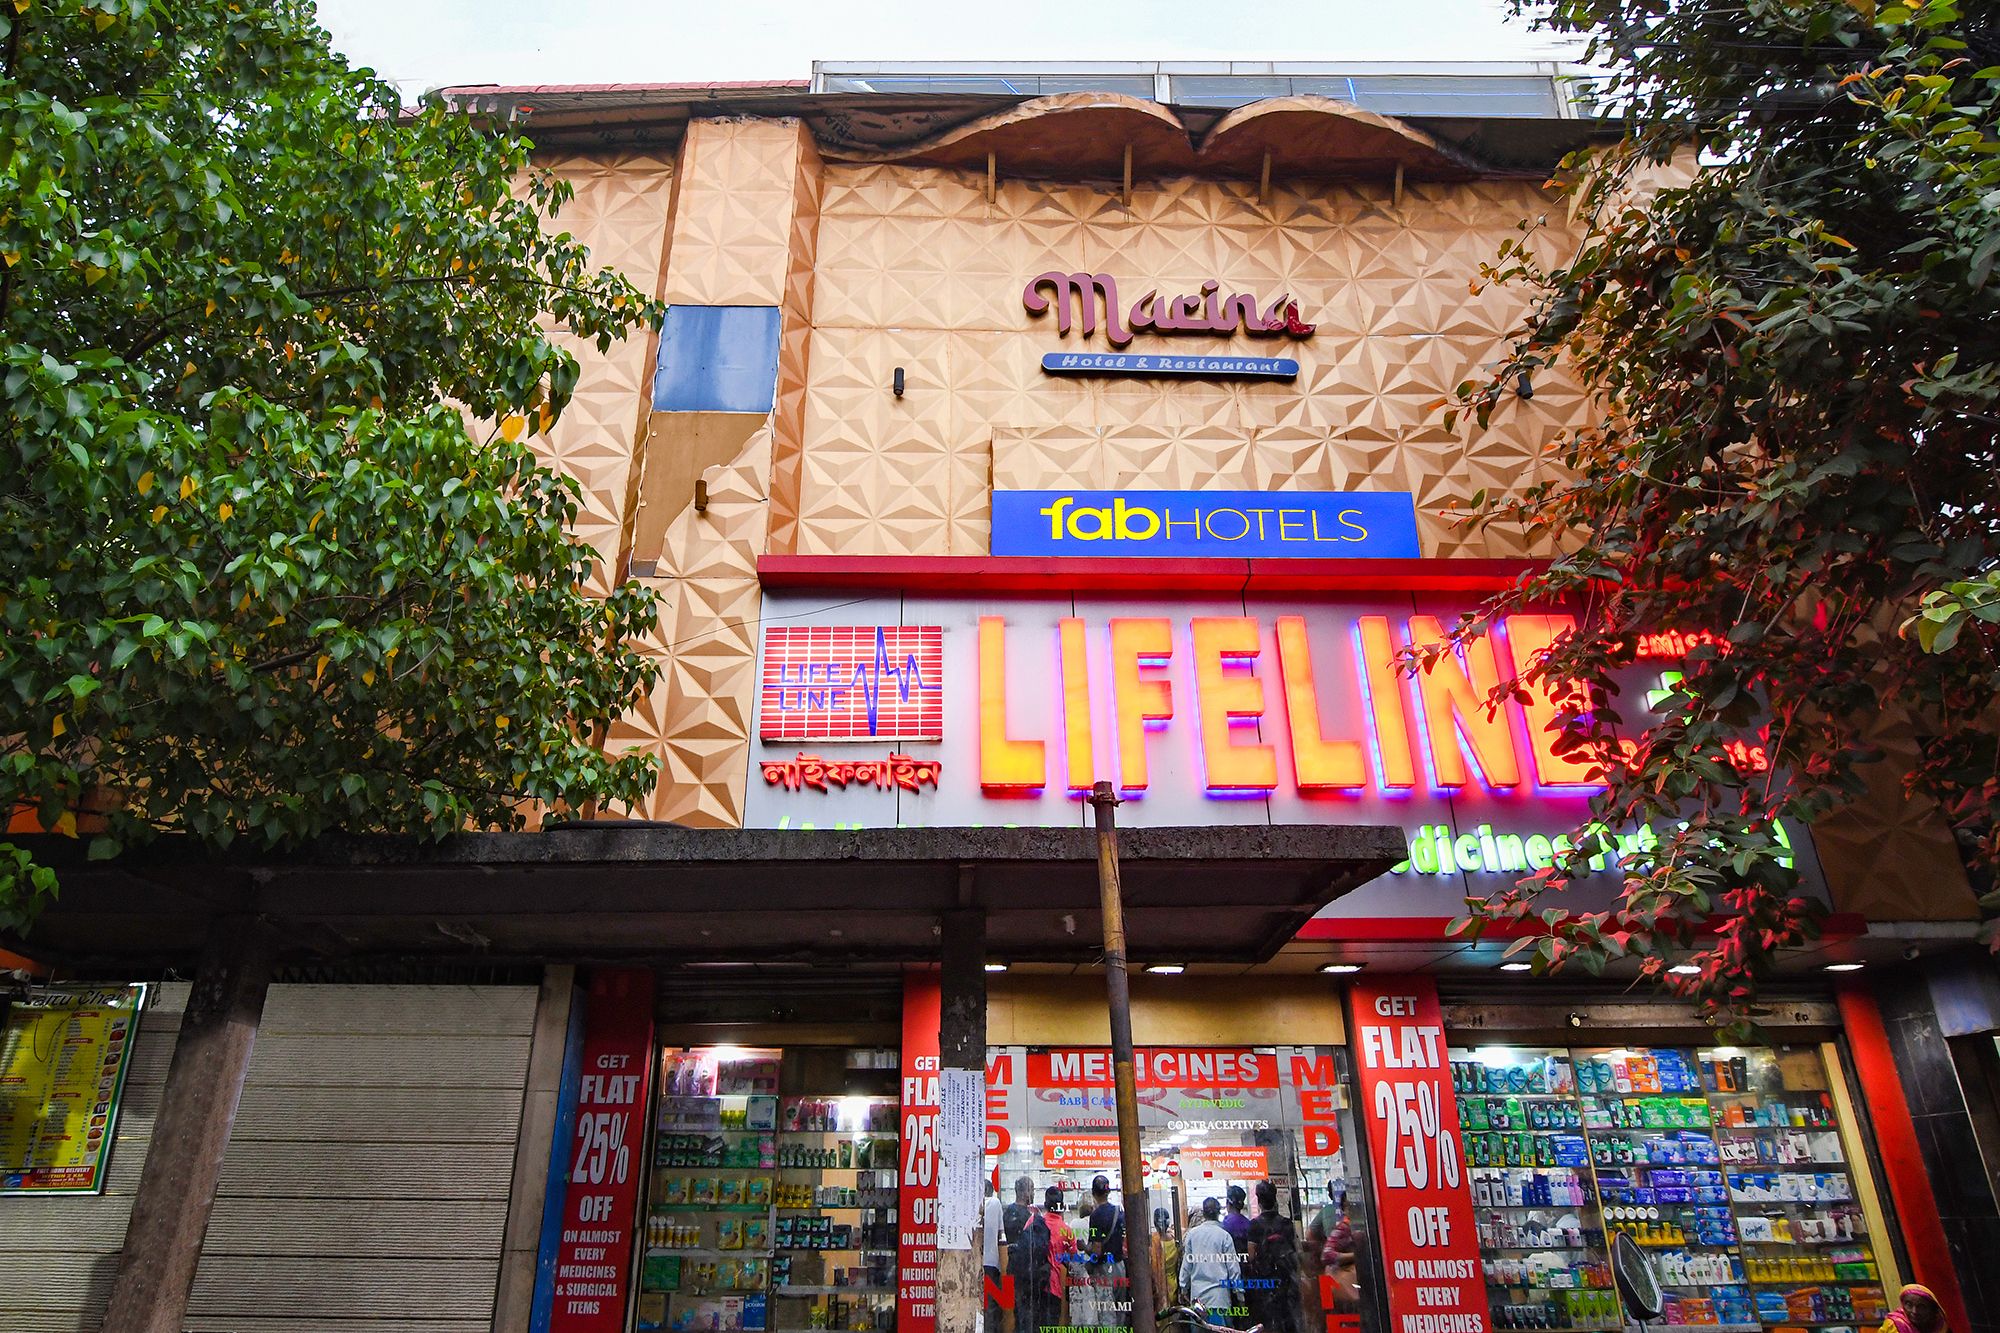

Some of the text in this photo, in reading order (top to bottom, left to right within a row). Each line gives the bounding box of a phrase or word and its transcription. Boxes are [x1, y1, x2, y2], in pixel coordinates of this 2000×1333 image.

[1022, 270, 1317, 348] Marina
[1061, 354, 1281, 374] Hotel & Restaurant
[781, 663, 842, 684] LIFE
[779, 690, 847, 711] LINE
[978, 614, 1608, 791] LIFELINE
[759, 752, 943, 794] লাইফলাইন
[1374, 996, 1417, 1017] GET
[1361, 1026, 1441, 1069] FLAT
[596, 1054, 630, 1069] GET
[1050, 1053, 1260, 1082] MEICINES
[579, 1075, 641, 1105] FLAT
[903, 1077, 940, 1106] FLA
[1091, 1096, 1116, 1106] CAR
[1178, 1099, 1246, 1109] AYURVEDIC
[1083, 1117, 1115, 1127] FOOD
[1167, 1120, 1269, 1130] CONTRACEPTIVES
[1374, 1080, 1460, 1190] 25%
[572, 1111, 631, 1185] 25%
[1075, 1148, 1097, 1157] 70440
[1212, 1159, 1235, 1168] 70440
[578, 1195, 614, 1222] OFF
[563, 1230, 621, 1243] ON ALMOST
[1407, 1206, 1451, 1247] OFF
[902, 1233, 914, 1245] ON
[574, 1248, 606, 1260] EVERY
[913, 1250, 936, 1263] EVER
[559, 1265, 616, 1278] MEDICINES
[1394, 1259, 1475, 1279] ON ALMOST
[556, 1282, 618, 1296] & SURGICAL
[901, 1287, 908, 1299] &
[1415, 1286, 1460, 1306] EVERY
[567, 1301, 600, 1314] ITEMS
[1216, 1306, 1249, 1316] CARE
[1402, 1313, 1484, 1333] MEDICINES
